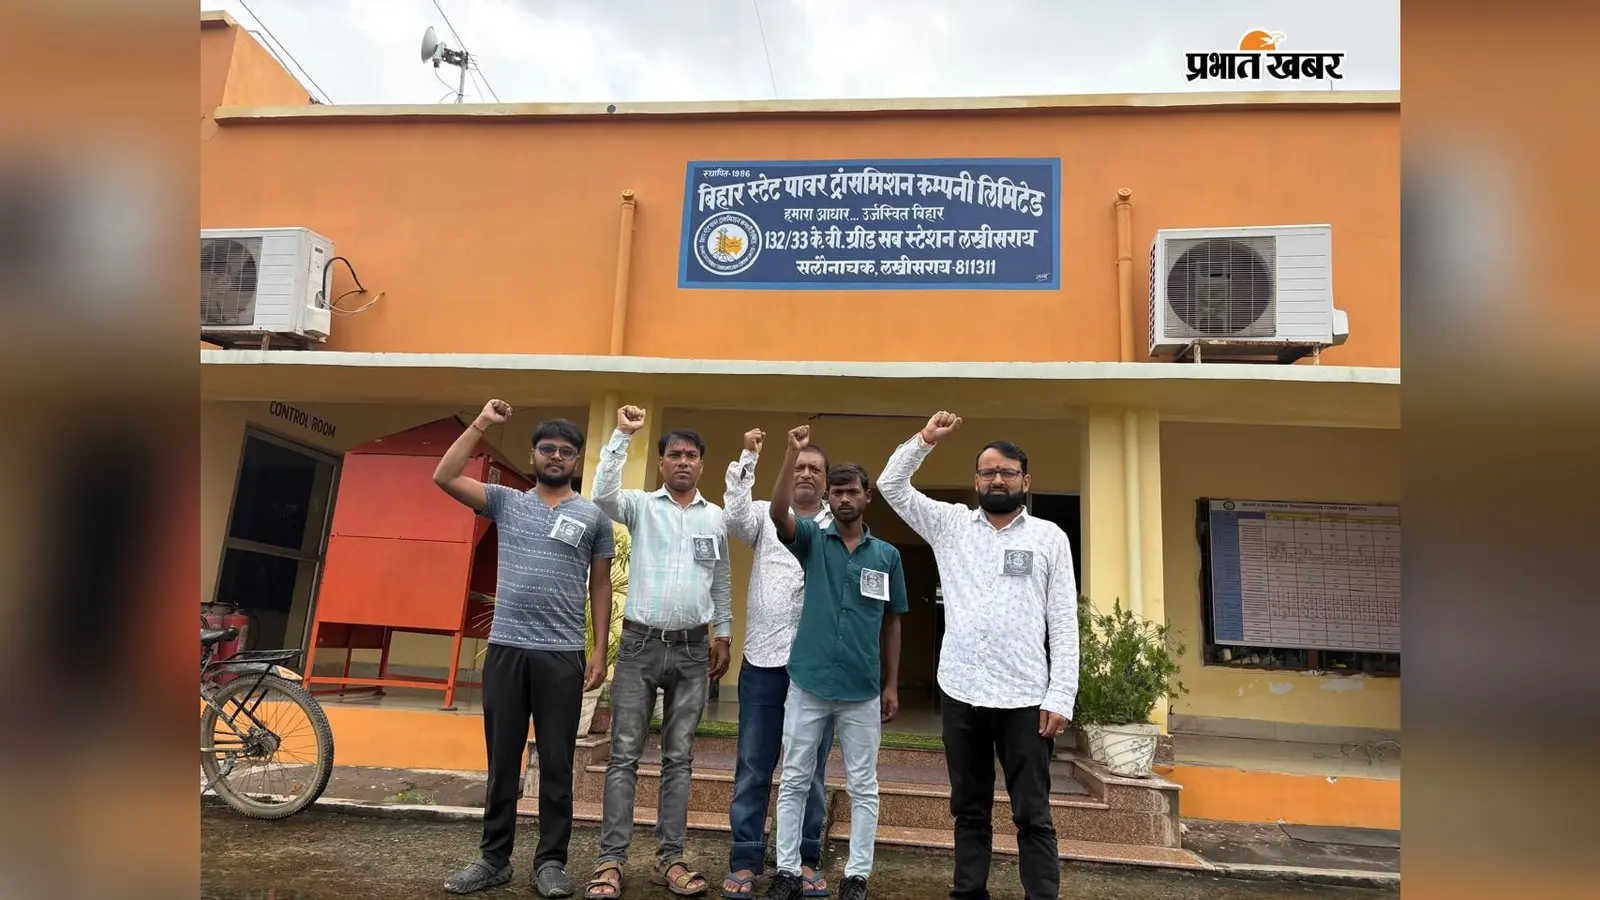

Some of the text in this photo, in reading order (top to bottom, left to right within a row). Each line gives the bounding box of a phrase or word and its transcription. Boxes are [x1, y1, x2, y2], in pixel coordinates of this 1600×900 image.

[697, 167, 1046, 217] बिहार स्टेट पावर ट्रांसमिशन कम्पनी लिमिटेड
[783, 208, 813, 223] हमारा
[912, 203, 945, 223] बिहार
[765, 230, 808, 250] 132/33
[845, 225, 877, 250] ग्रीड
[877, 230, 904, 249] सब
[904, 224, 957, 250] स्टेशन
[958, 223, 1038, 250] लखीसराय
[269, 400, 337, 439] CONTROL ROOM
